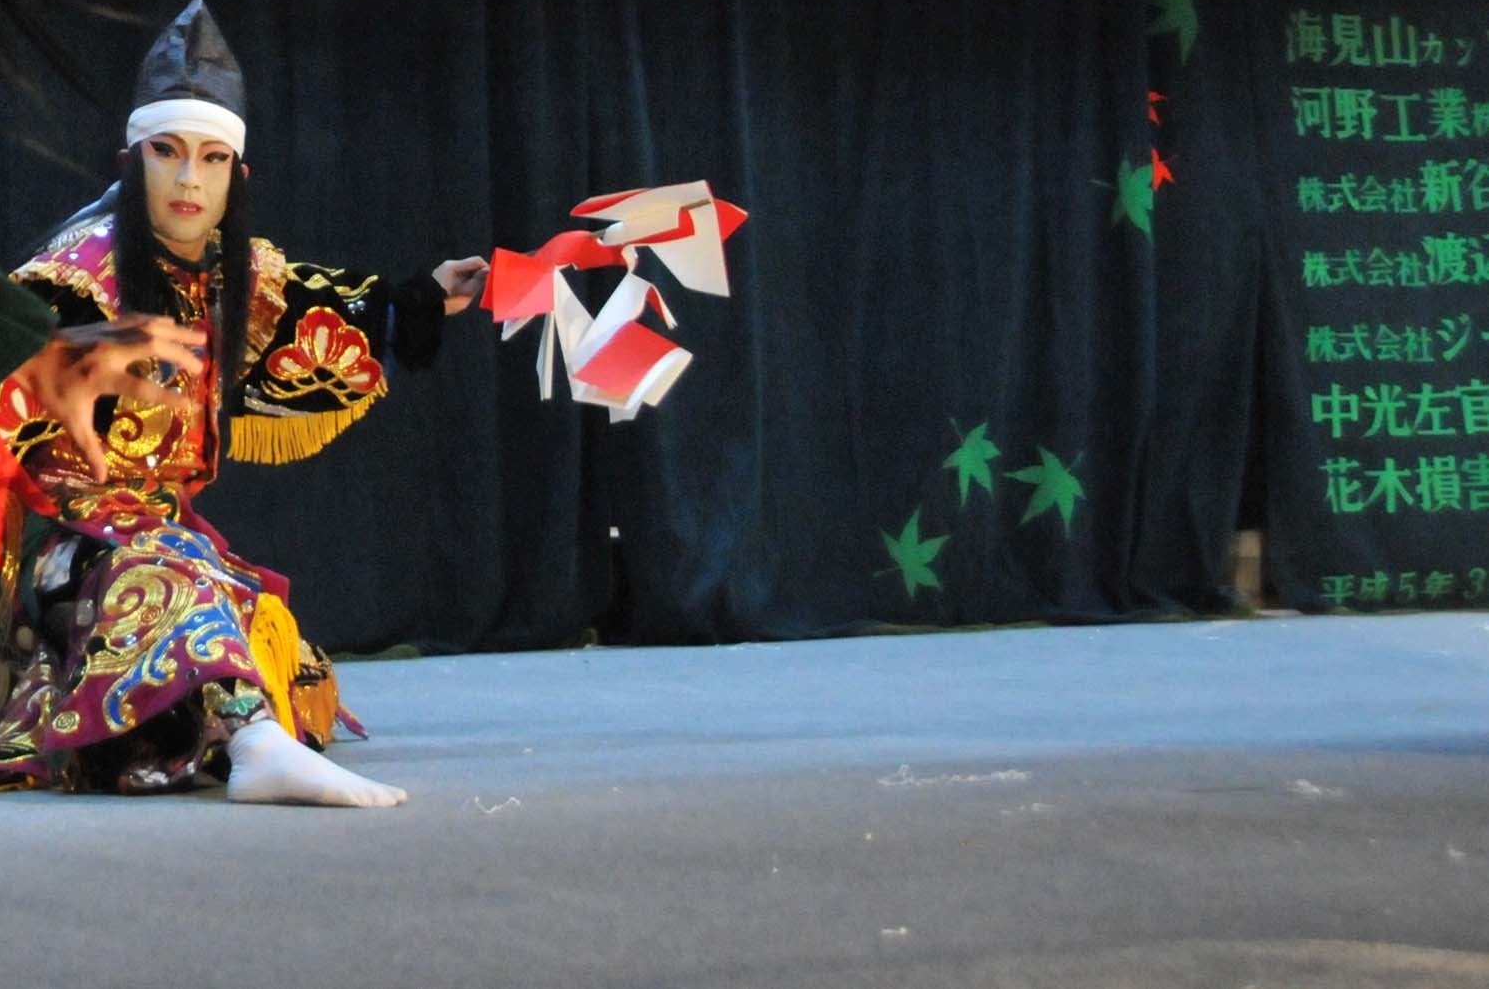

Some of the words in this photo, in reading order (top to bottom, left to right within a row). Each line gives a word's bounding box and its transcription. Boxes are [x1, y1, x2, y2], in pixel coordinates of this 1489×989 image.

[1306, 313, 1489, 362] 株式会社ジ
